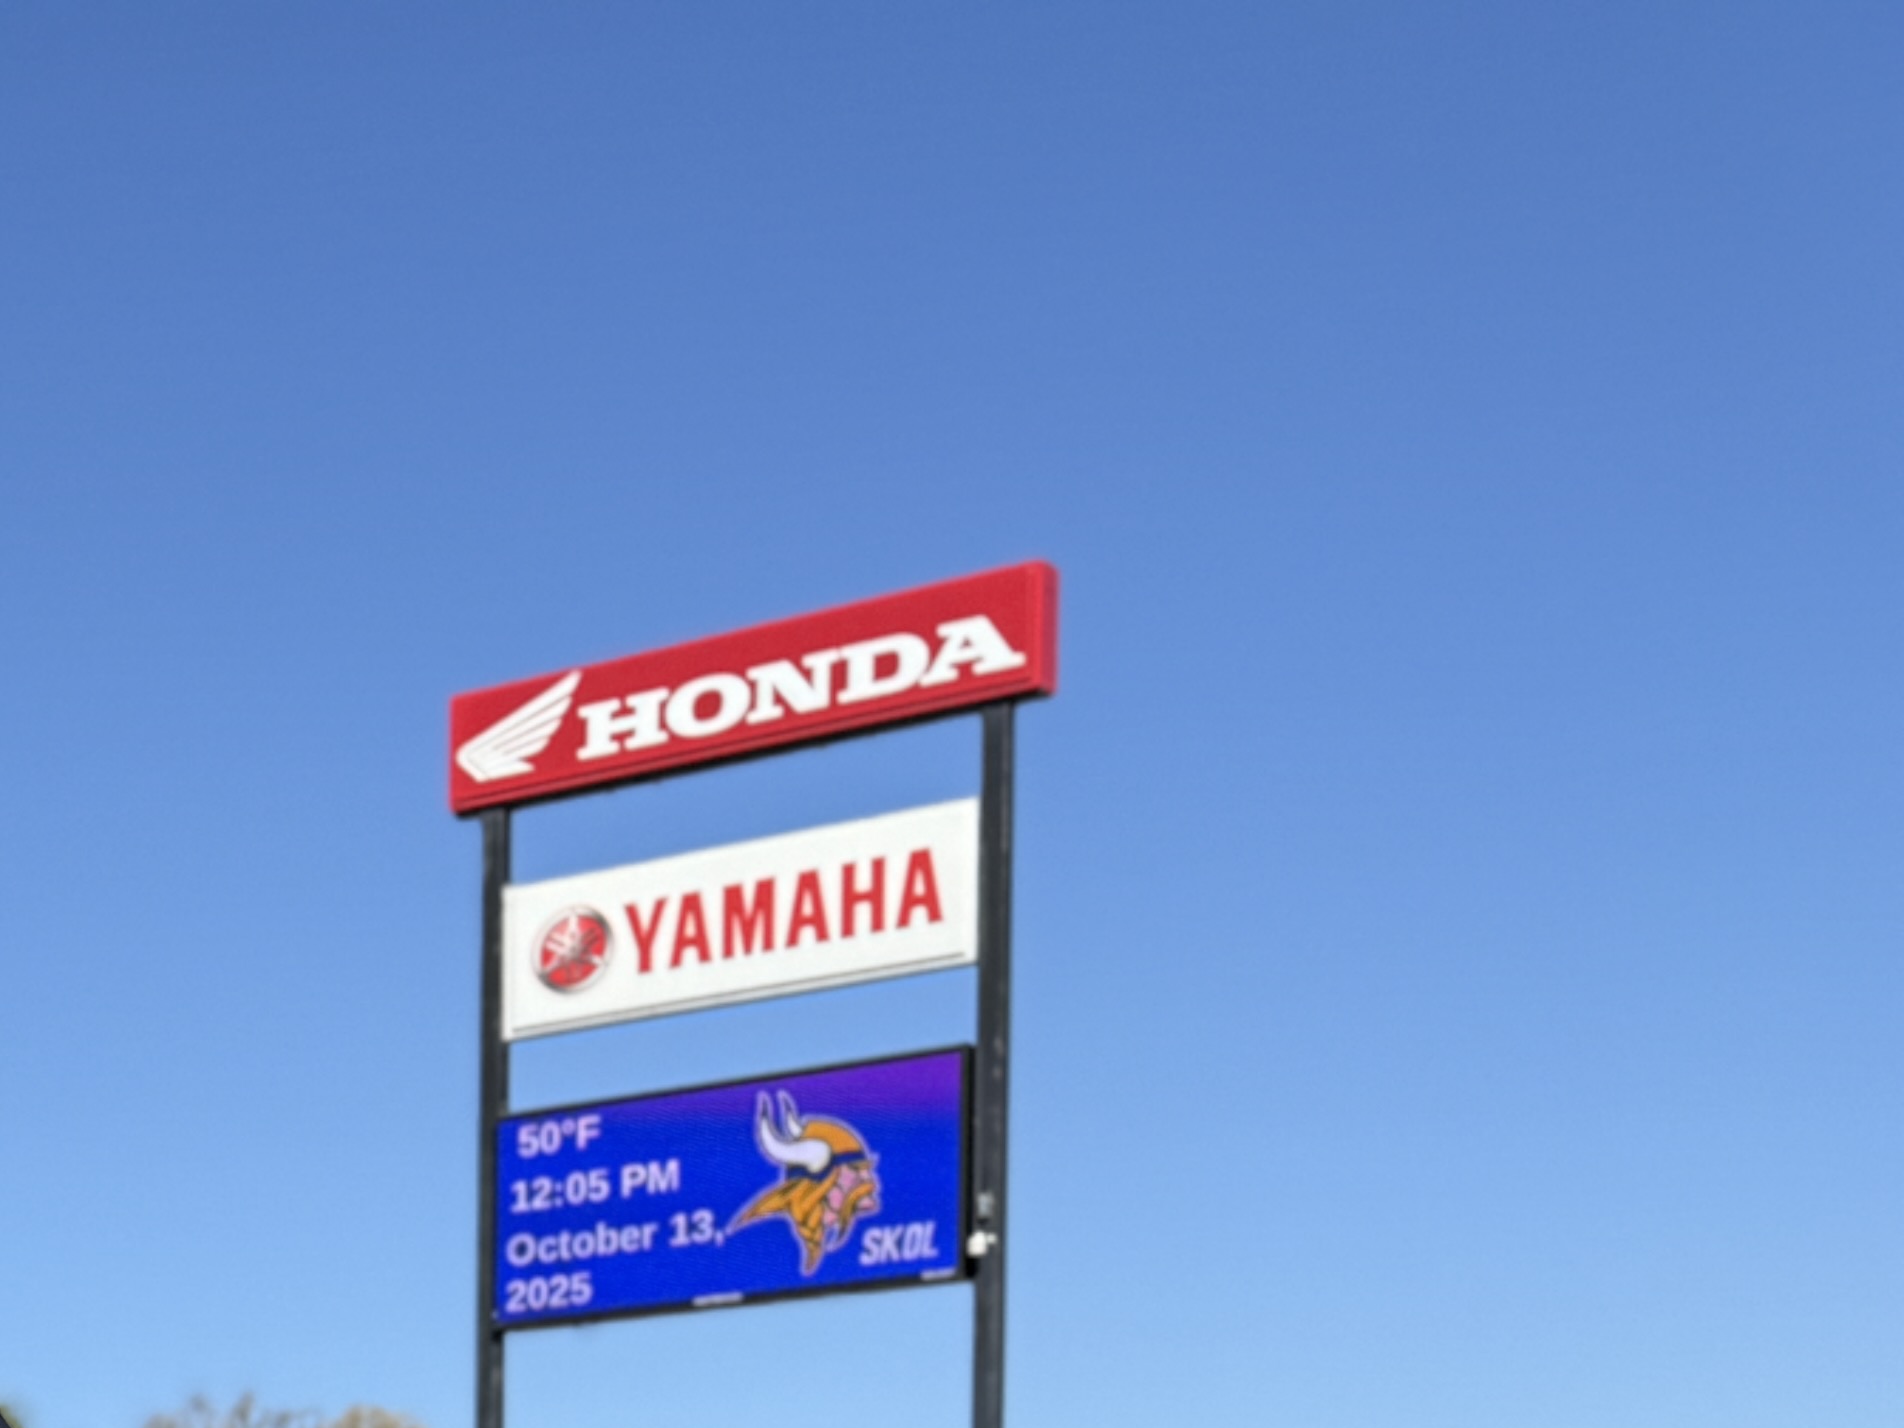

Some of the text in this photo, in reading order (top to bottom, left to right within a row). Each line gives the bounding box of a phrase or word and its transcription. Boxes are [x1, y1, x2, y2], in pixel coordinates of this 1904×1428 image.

[576, 614, 1026, 761] HONDA
[624, 847, 943, 974] YAMAHA
[510, 1159, 681, 1214] 12:05 PM
[506, 1209, 725, 1267] October 13,
[859, 1221, 938, 1267] SKOL
[505, 1272, 592, 1313] 2025
